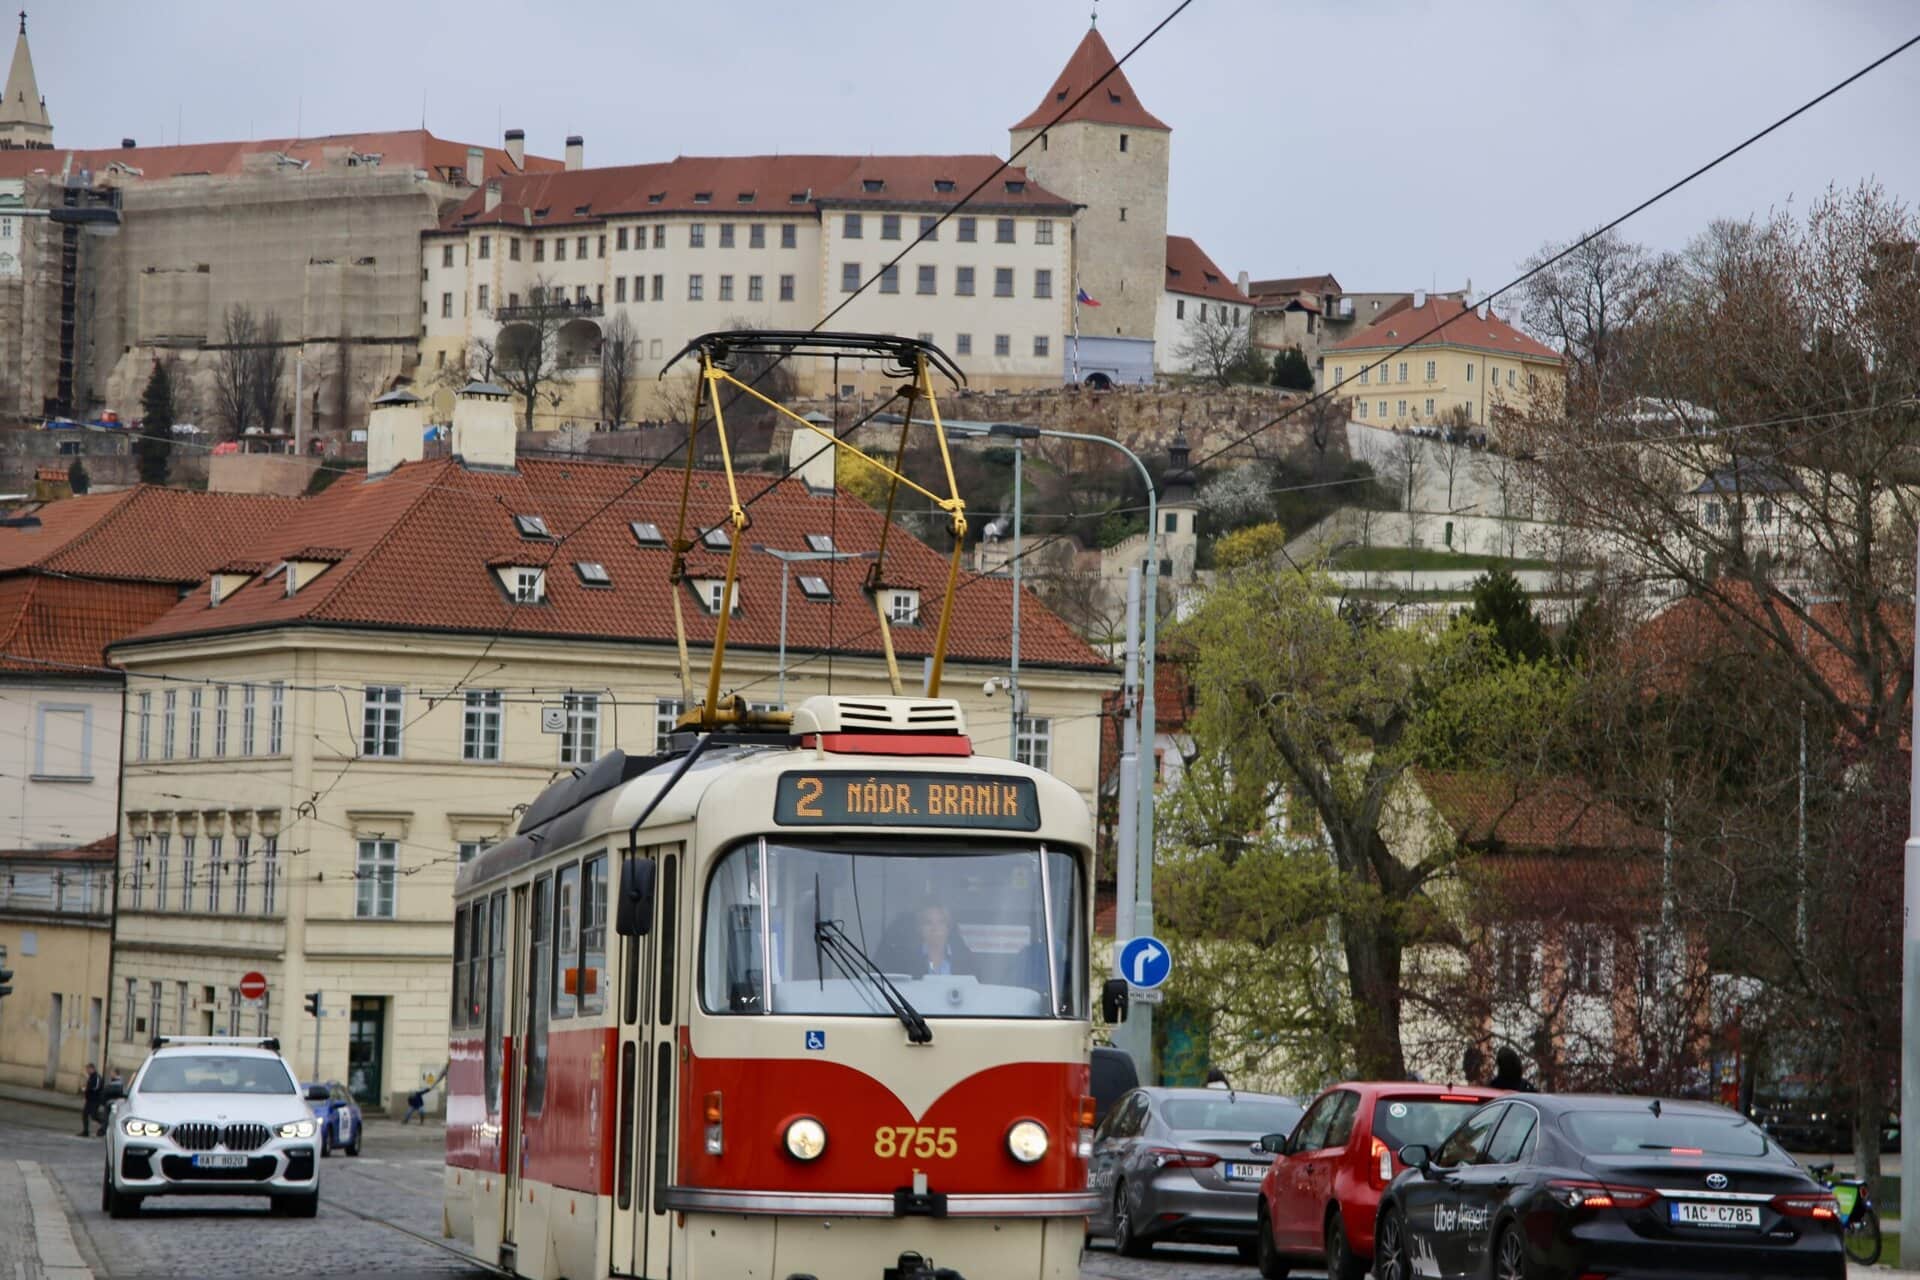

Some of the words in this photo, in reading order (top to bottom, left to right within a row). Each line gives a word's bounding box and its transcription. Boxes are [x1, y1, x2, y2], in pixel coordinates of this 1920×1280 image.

[796, 776, 824, 817] 2
[847, 777, 919, 814] NÁDR.
[874, 1126, 957, 1159] 8755
[1434, 1203, 1457, 1232] Uber
[1683, 1205, 1708, 1220] 1AC
[1718, 1207, 1753, 1222] C785
